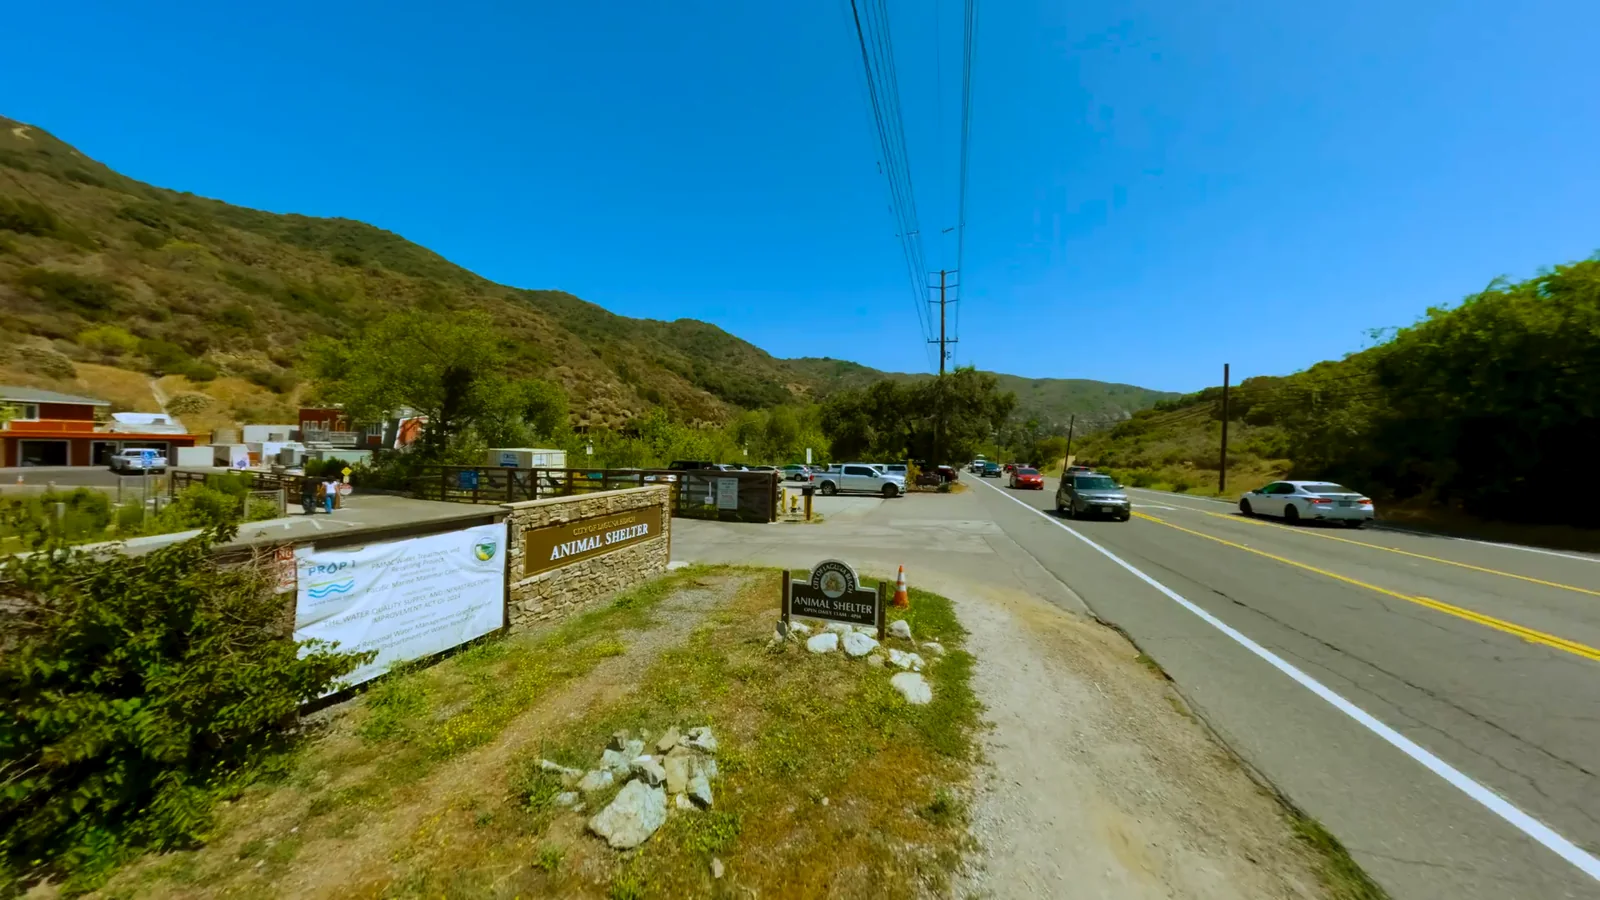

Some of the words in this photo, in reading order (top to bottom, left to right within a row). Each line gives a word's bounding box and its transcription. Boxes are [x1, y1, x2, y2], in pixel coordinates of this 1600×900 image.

[573, 526, 588, 536] CITY
[588, 524, 597, 533] OF
[597, 518, 619, 530] LAGUNA
[550, 534, 603, 561] ANIMAL
[605, 523, 649, 545] SHELTER
[308, 561, 348, 576] PROP
[812, 575, 820, 590] CITY
[342, 609, 370, 622] WATER
[371, 601, 402, 616] QUALITY
[373, 603, 422, 623] IMPROVEMENT
[794, 596, 830, 609] ANIMAL
[832, 600, 872, 614] SHELTER
